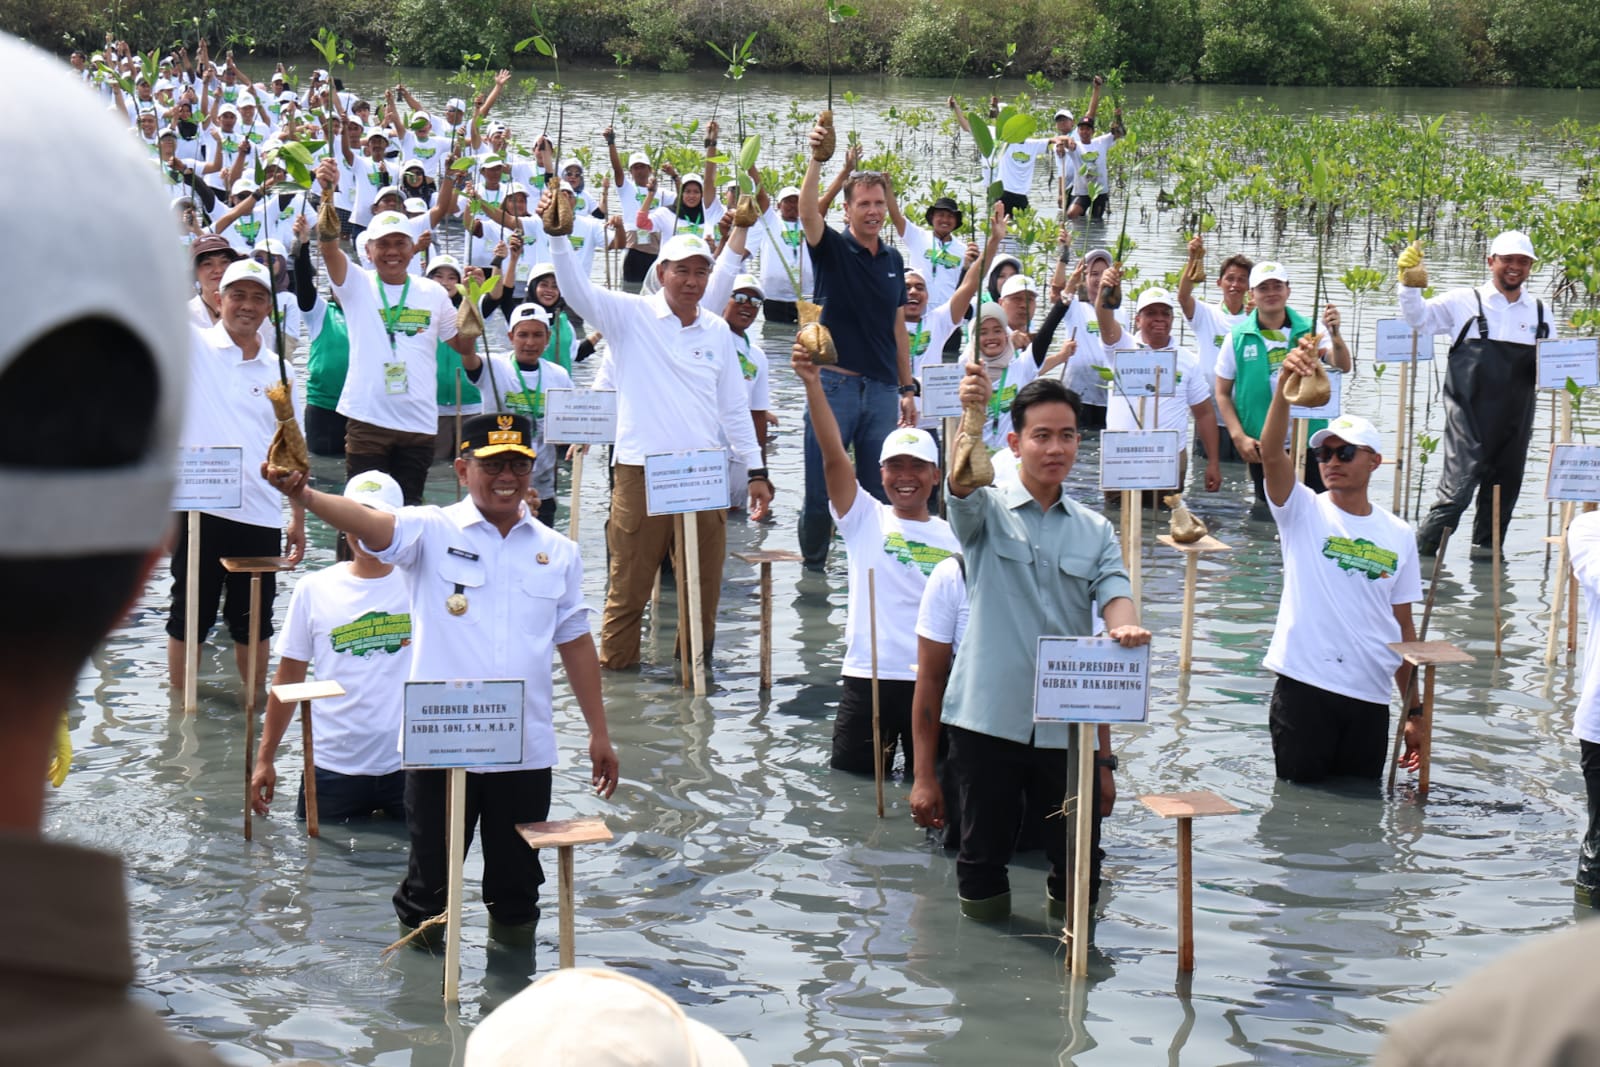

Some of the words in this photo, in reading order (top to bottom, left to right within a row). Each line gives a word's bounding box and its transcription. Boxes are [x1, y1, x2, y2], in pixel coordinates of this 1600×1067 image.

[1047, 660, 1076, 671] WAKIL
[1079, 661, 1125, 672] PRESIDEN
[1129, 662, 1140, 673] RI
[1042, 677, 1078, 689] GIBRAN
[1082, 679, 1142, 690] RAKABUMING
[422, 704, 469, 715] GUBERNUR
[473, 703, 507, 713] BANTEN
[411, 723, 439, 734] ANDRA
